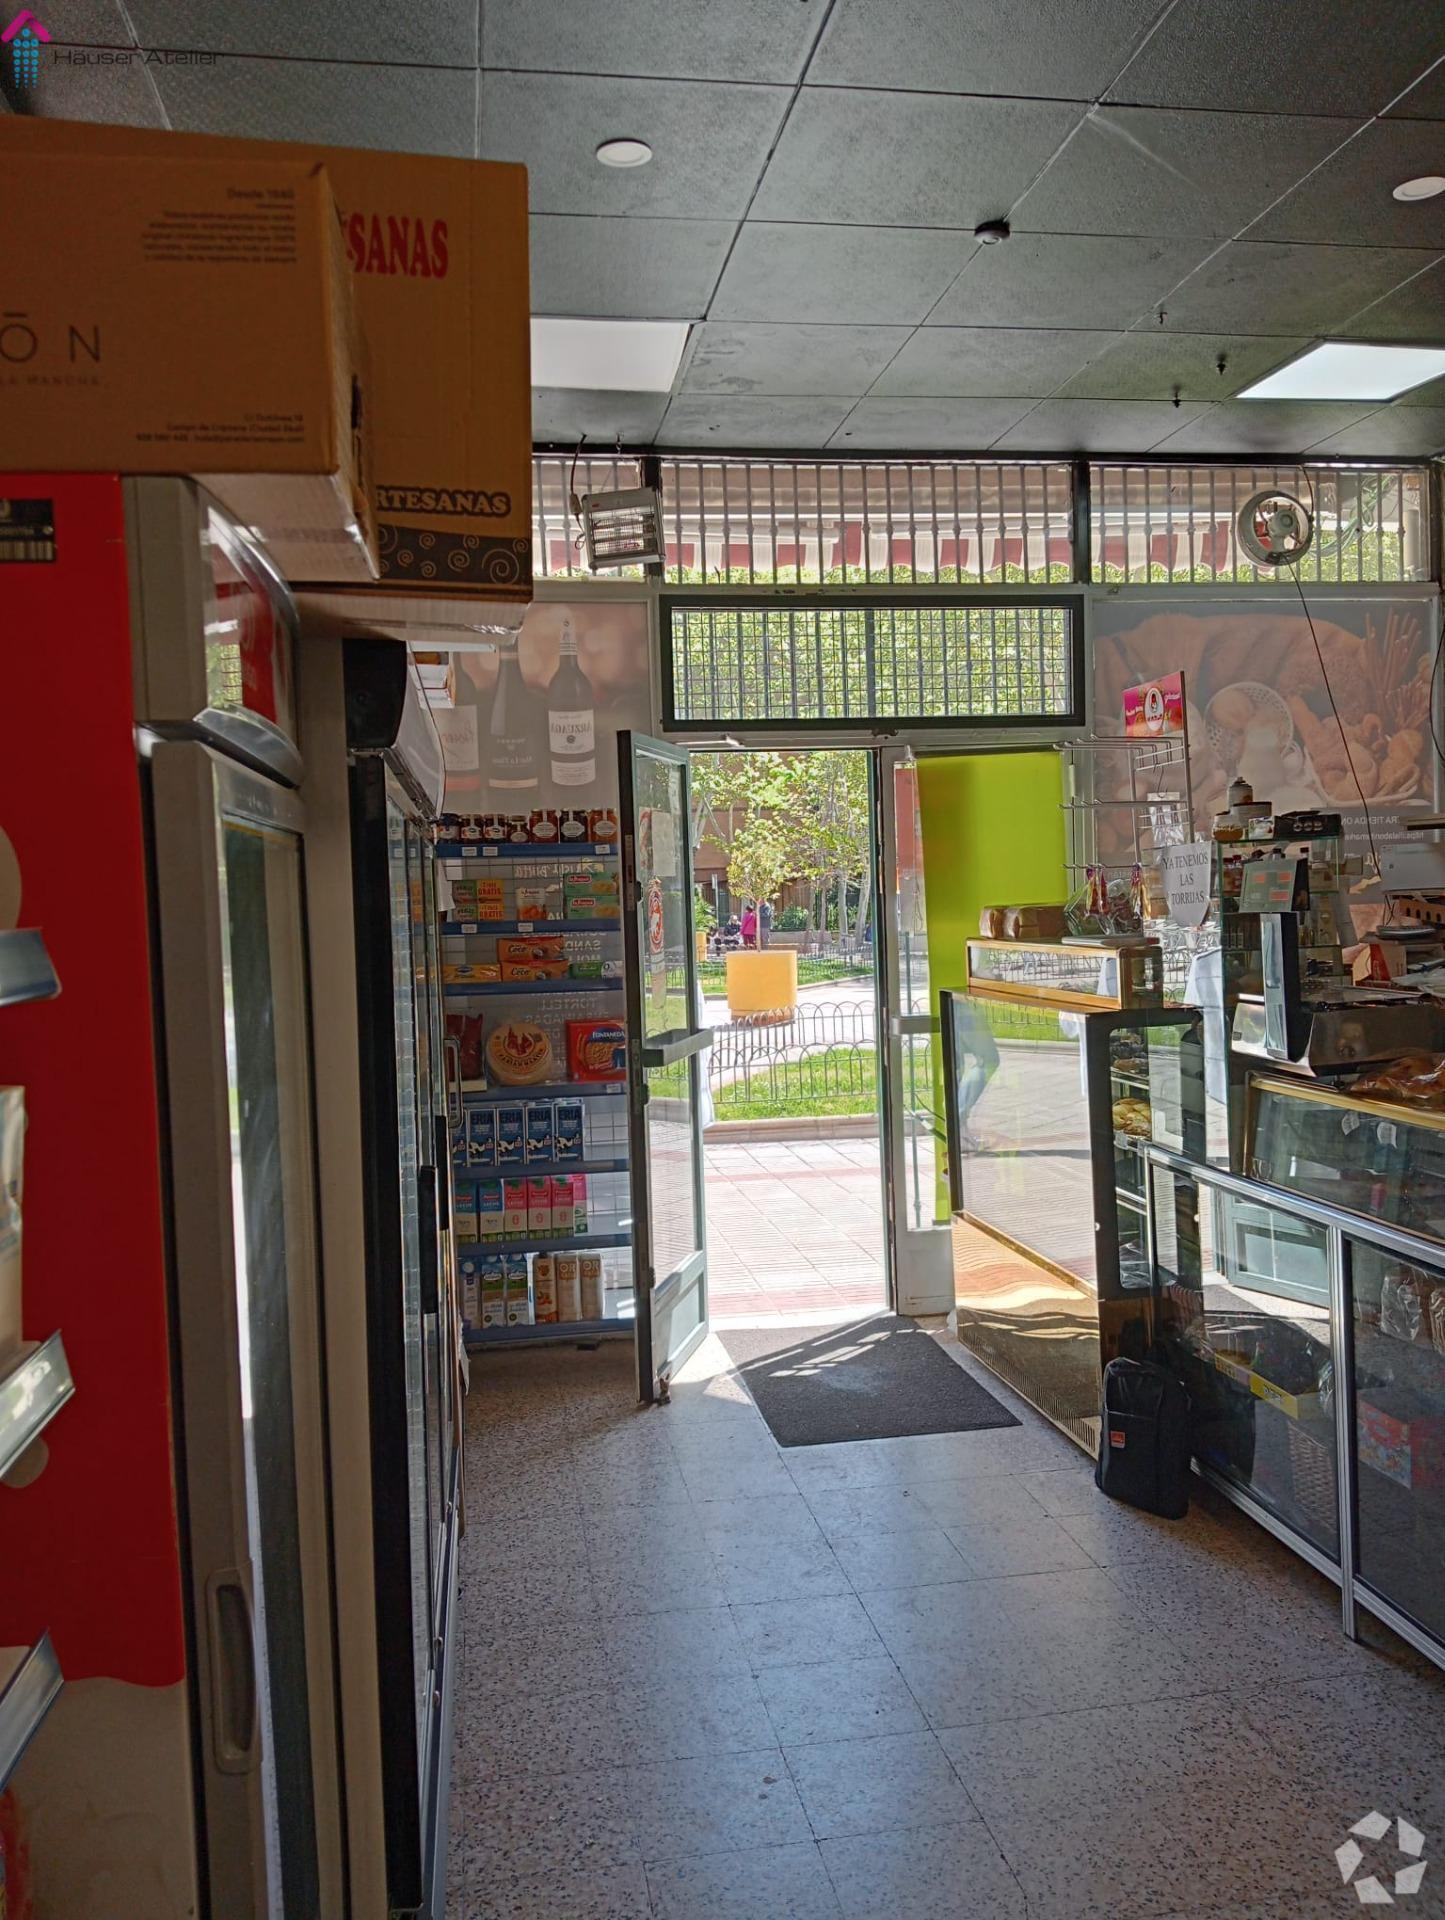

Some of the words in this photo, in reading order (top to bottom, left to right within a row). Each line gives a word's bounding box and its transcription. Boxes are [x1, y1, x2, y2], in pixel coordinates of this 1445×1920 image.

[342, 212, 449, 279] SANAS
[1162, 857, 1174, 869] YA
[1174, 852, 1208, 868] TENEMOS
[1180, 873, 1194, 886] LAS
[1171, 891, 1204, 904] TORRIJAS
